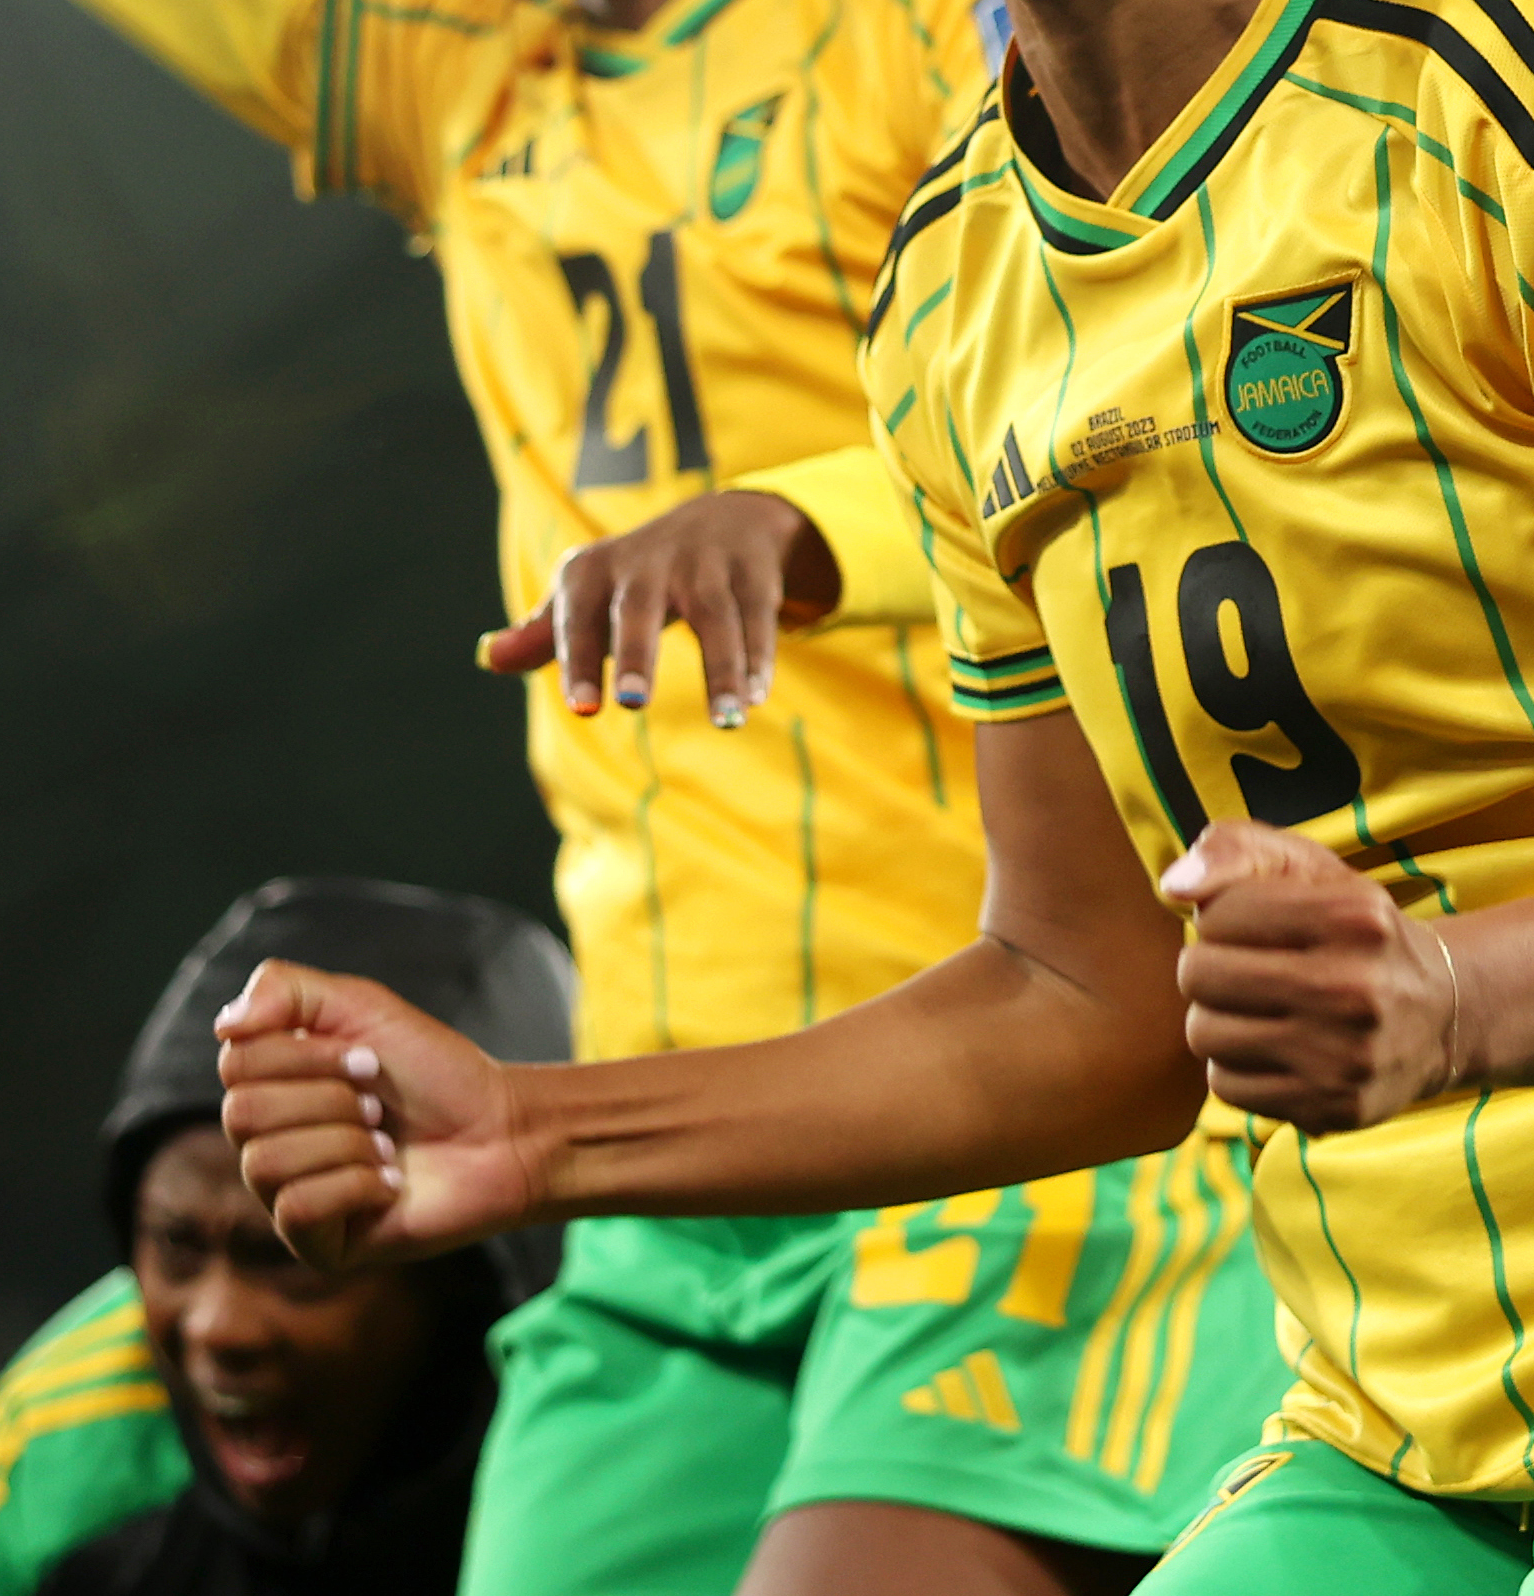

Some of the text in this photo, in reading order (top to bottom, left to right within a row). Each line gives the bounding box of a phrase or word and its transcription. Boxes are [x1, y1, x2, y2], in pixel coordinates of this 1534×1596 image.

[558, 231, 711, 486] 21
[1241, 340, 1307, 369] FOOTBALL
[1236, 369, 1330, 413] JAMAICA
[1086, 426, 1125, 452] AUGUST
[1125, 416, 1156, 438] 2023
[1089, 406, 1124, 431] BRAZIL
[1164, 420, 1221, 447] STADIUM
[1252, 410, 1322, 440] FEDERATION
[1105, 540, 1361, 850] 19
